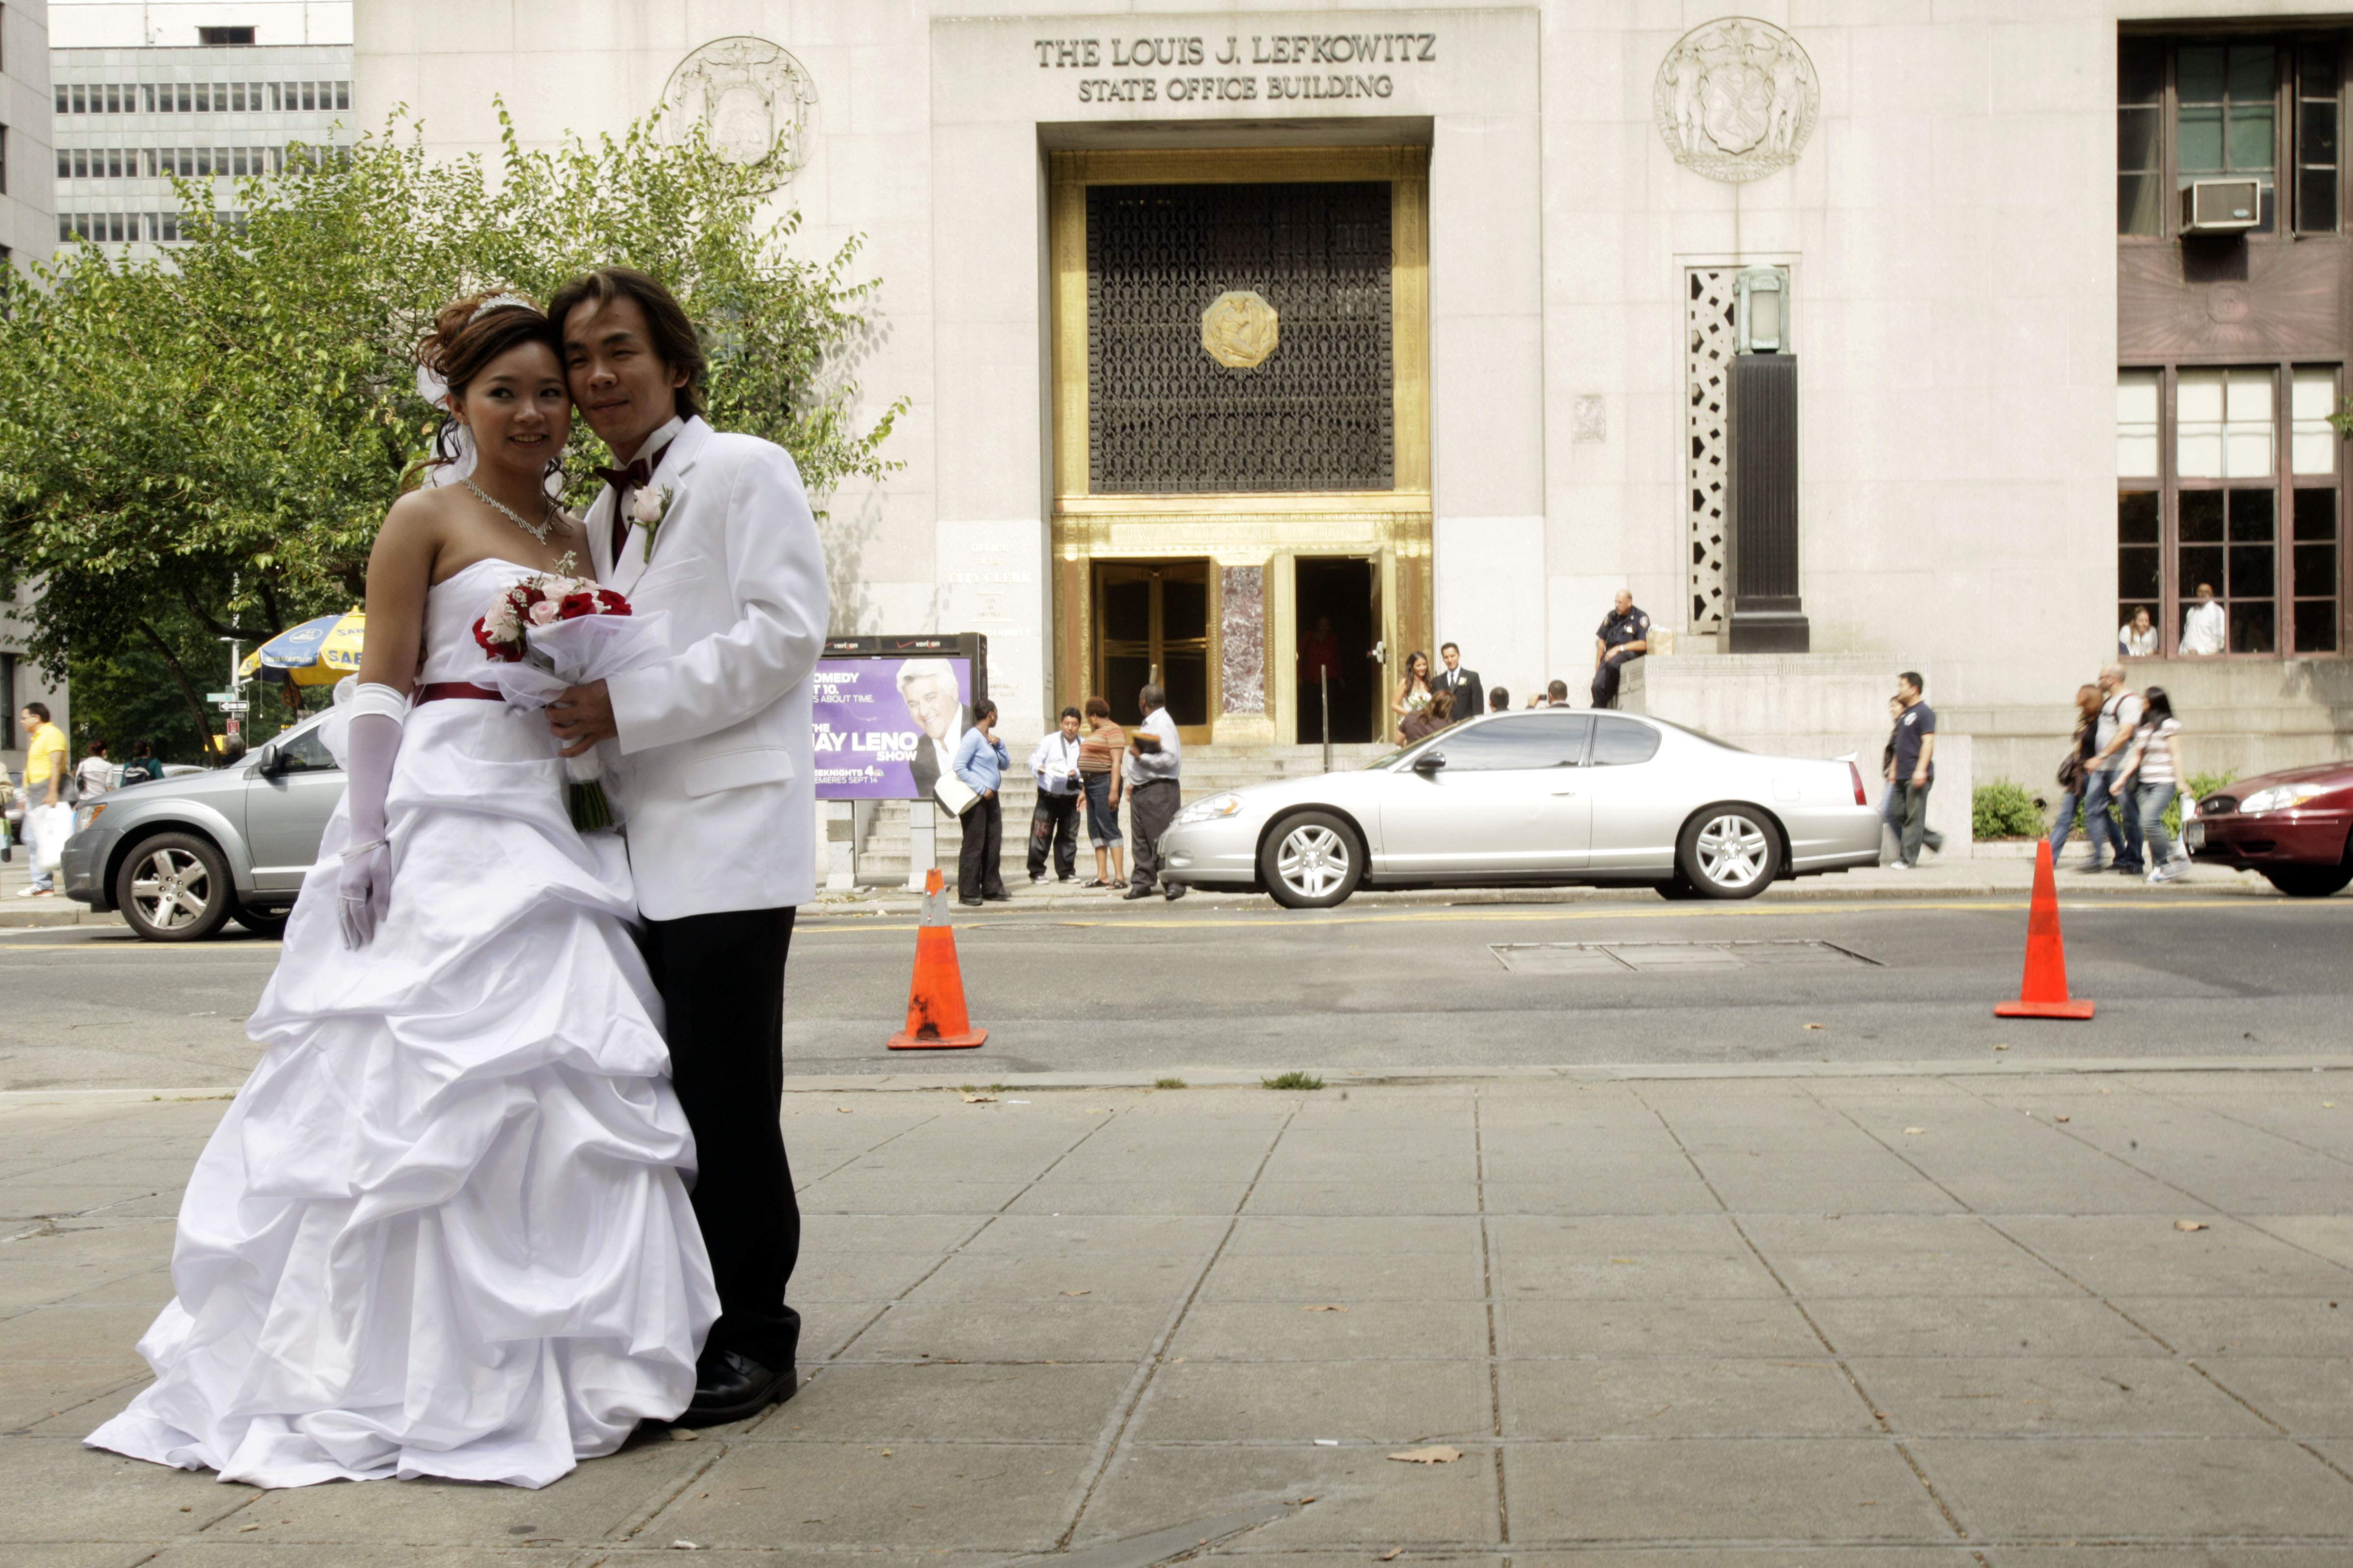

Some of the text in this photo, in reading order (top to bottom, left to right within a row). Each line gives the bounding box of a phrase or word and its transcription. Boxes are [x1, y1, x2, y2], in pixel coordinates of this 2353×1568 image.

[1034, 33, 1436, 68] THE LOUIS J. LEFKOWITZ
[1079, 74, 1394, 102] STATE OFFICE BUILDING
[1116, 524, 1366, 541] NEW YORK STATE BUILDING
[328, 650, 362, 666] SAB
[814, 672, 859, 683] OMEDY
[813, 684, 839, 694] T 10.
[812, 723, 830, 733] HE
[812, 732, 918, 751] AY LENO
[877, 751, 917, 761] SHOW
[864, 765, 874, 776] 4
